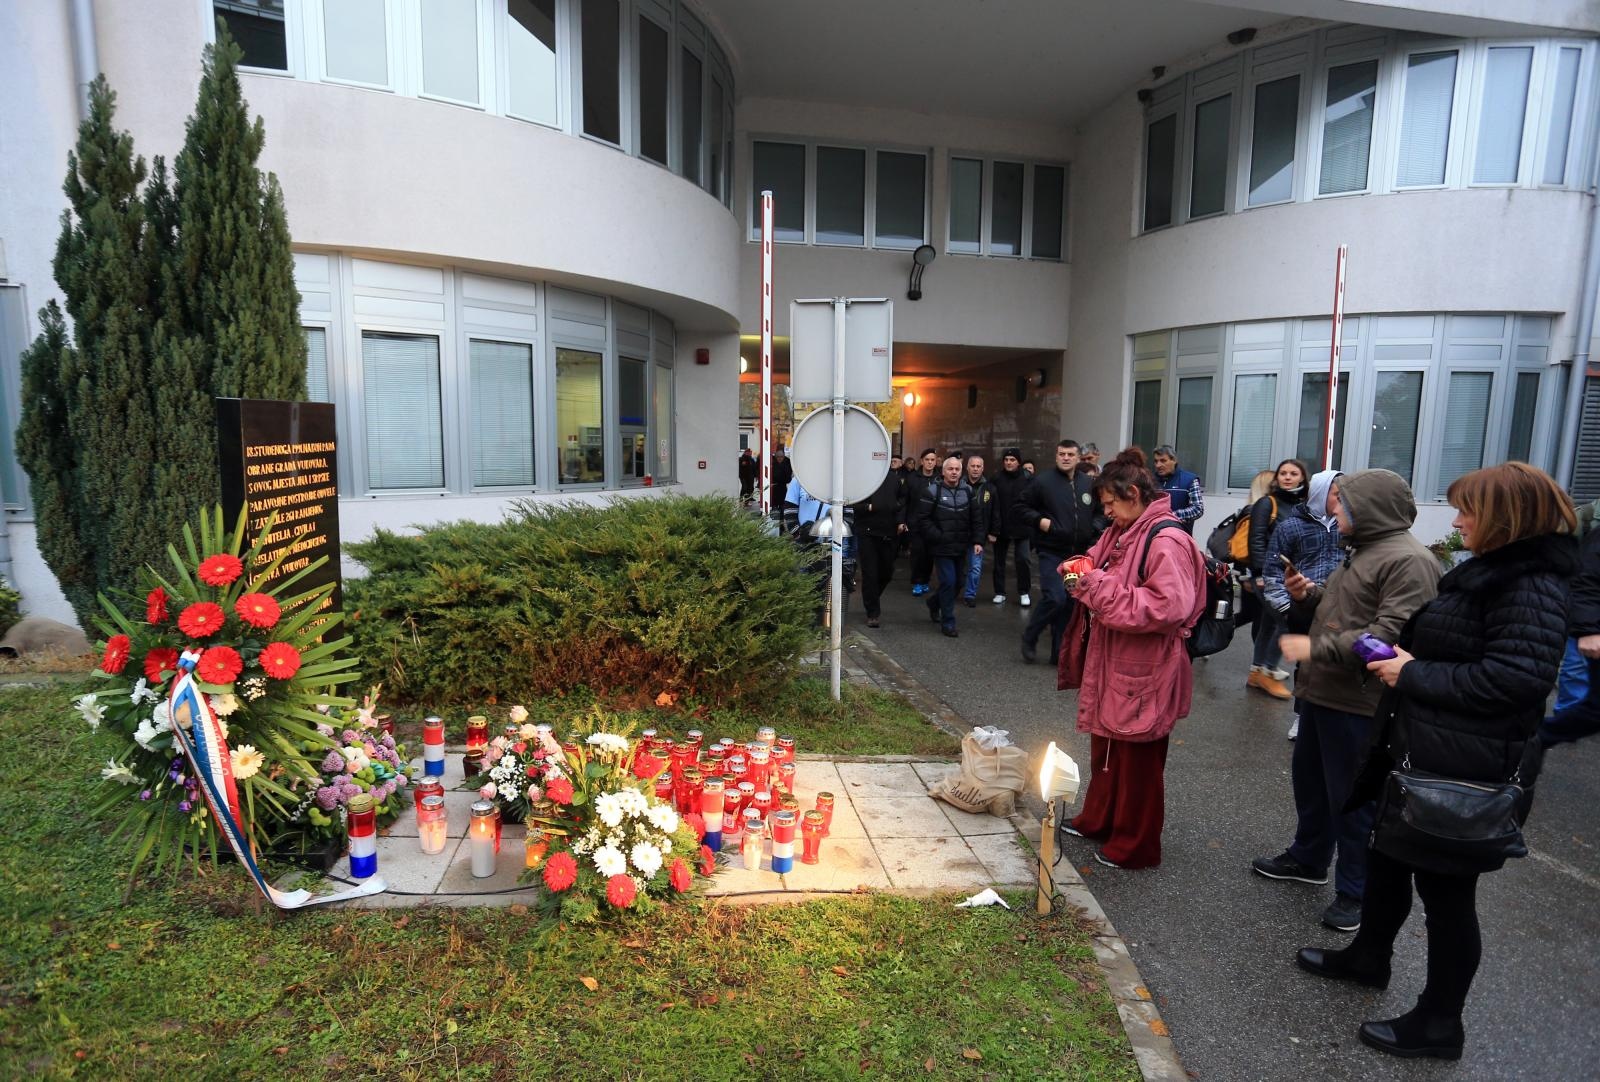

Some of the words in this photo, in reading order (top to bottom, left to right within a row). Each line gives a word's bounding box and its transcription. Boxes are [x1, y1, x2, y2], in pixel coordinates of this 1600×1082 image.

[247, 463, 275, 476] OBRANE
[275, 461, 297, 472] GRADA
[248, 483, 253, 494] S
[253, 480, 272, 493] OVOG
[272, 477, 296, 490] MJESTA
[249, 496, 287, 512] PARAVOJNE
